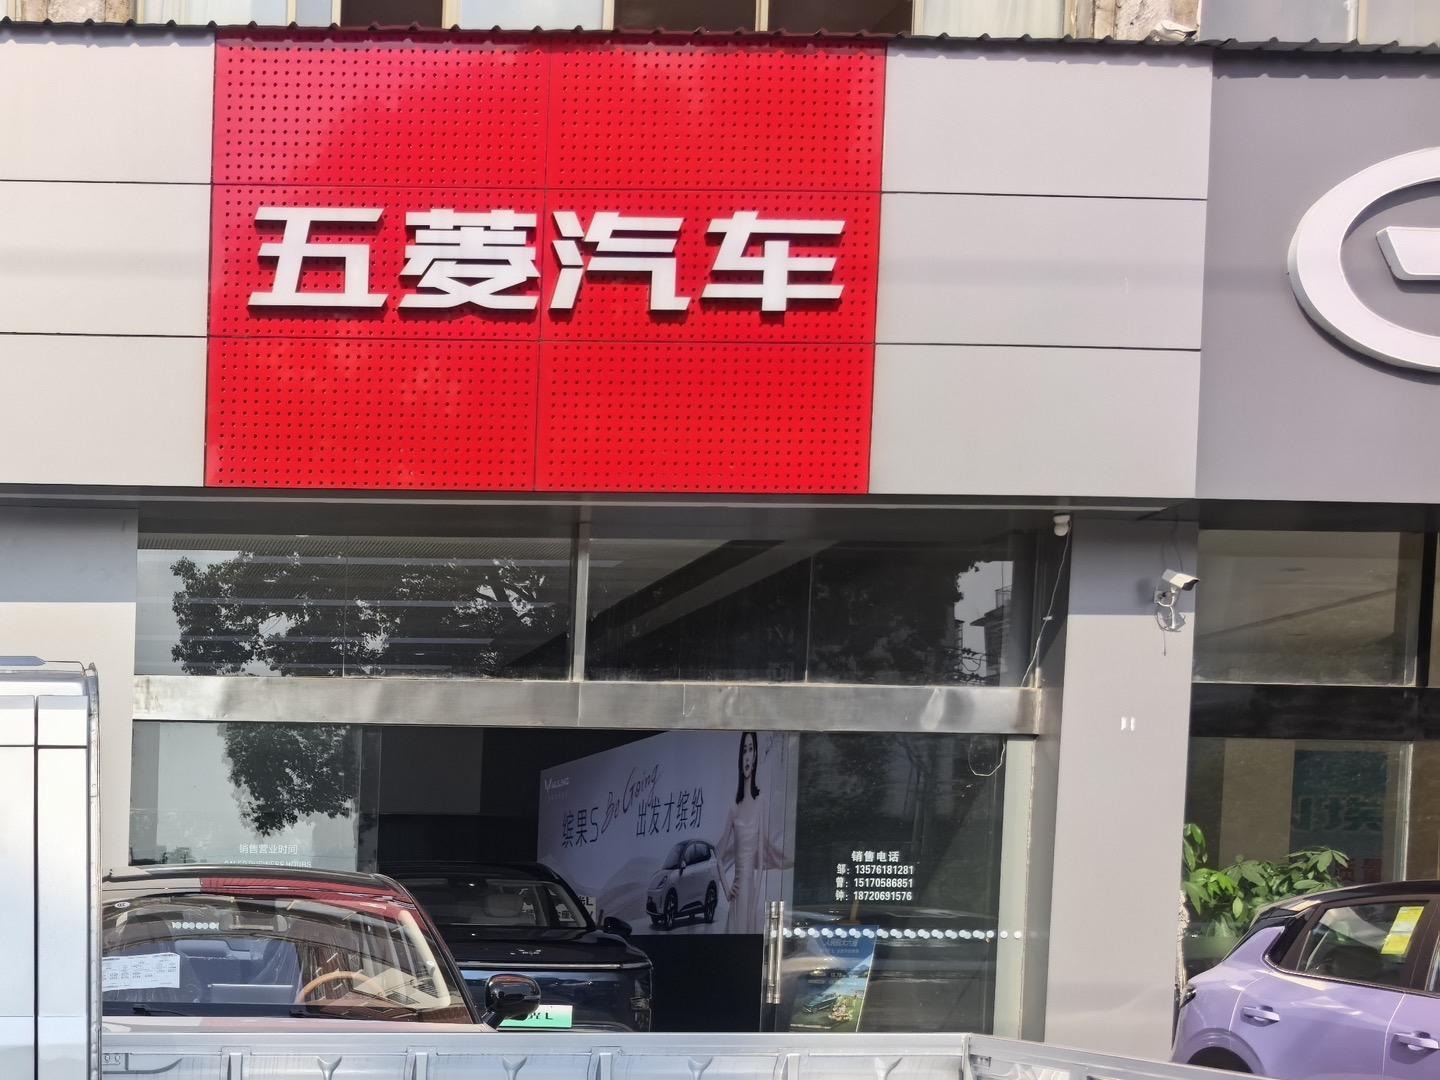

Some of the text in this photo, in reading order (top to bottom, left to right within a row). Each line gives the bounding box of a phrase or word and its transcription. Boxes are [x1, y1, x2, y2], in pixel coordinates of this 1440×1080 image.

[248, 206, 847, 312] 五菱汽车
[636, 787, 704, 837] 出发才缤纷
[851, 851, 900, 862] 销售电话
